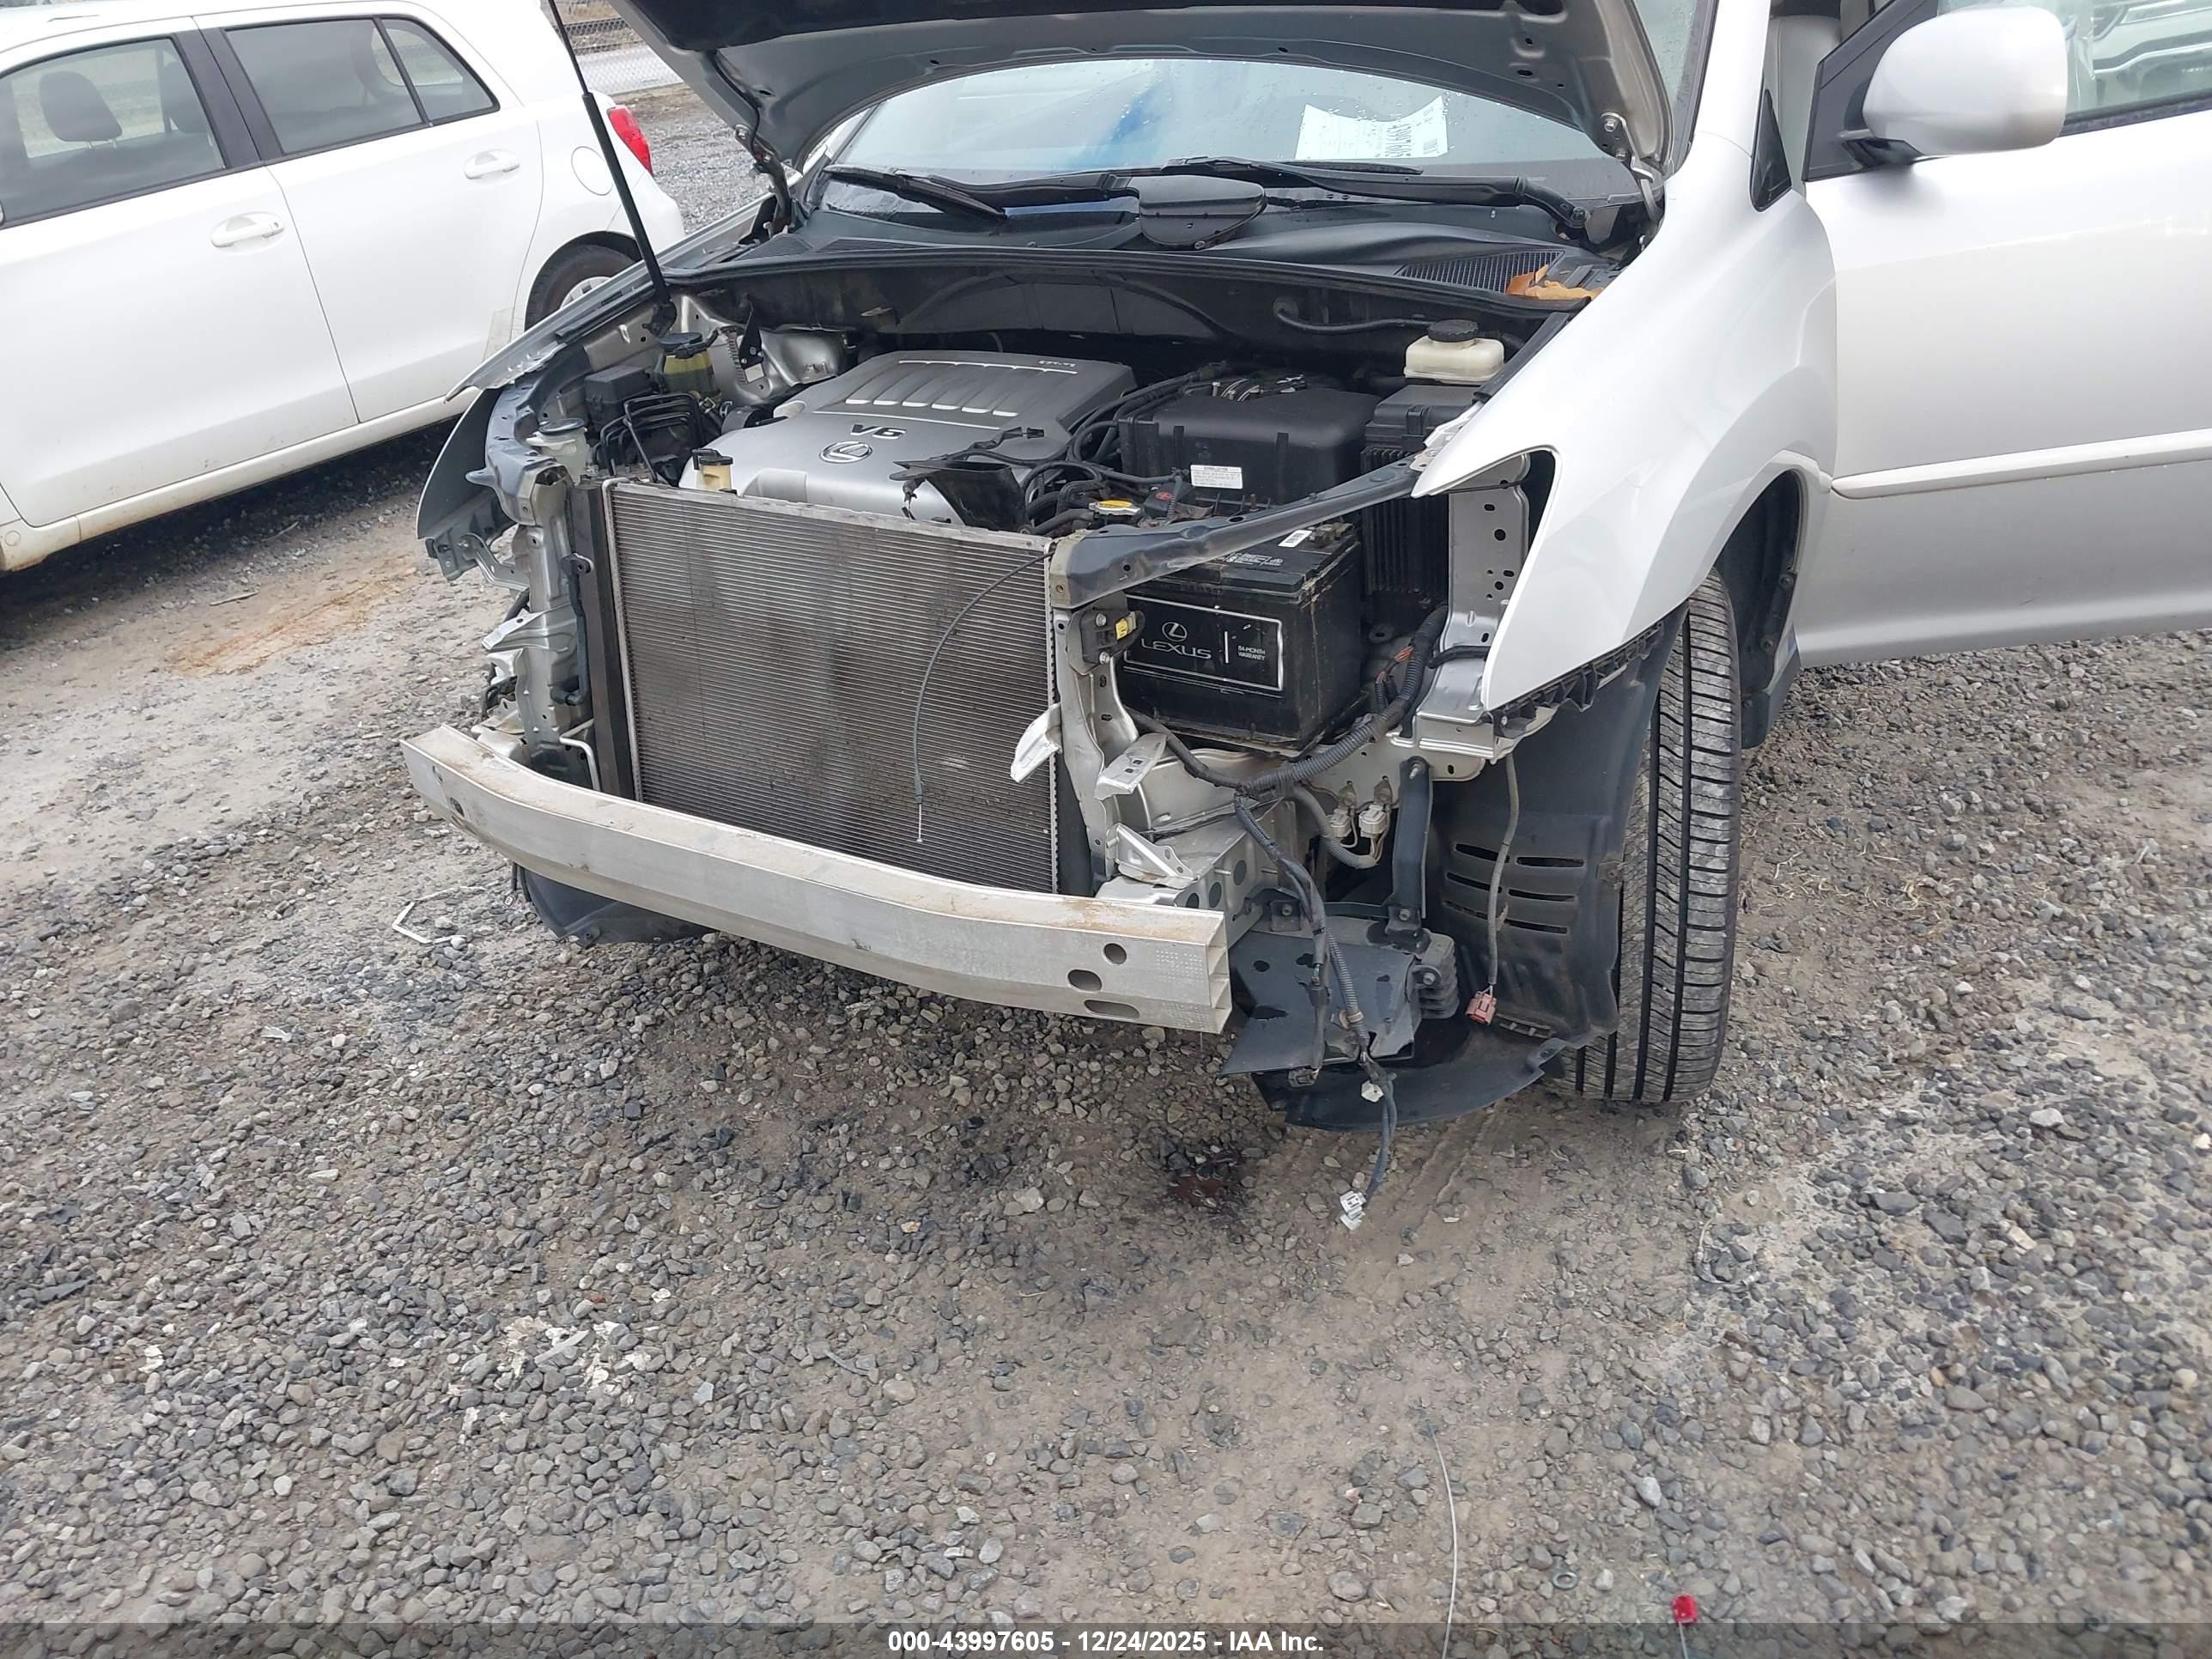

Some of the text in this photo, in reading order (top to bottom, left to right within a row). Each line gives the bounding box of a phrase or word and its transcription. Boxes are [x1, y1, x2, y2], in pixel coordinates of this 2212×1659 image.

[850, 423, 907, 440] V6
[1140, 638, 1212, 659] LEXUS
[1237, 651, 1266, 661] WARRANTY
